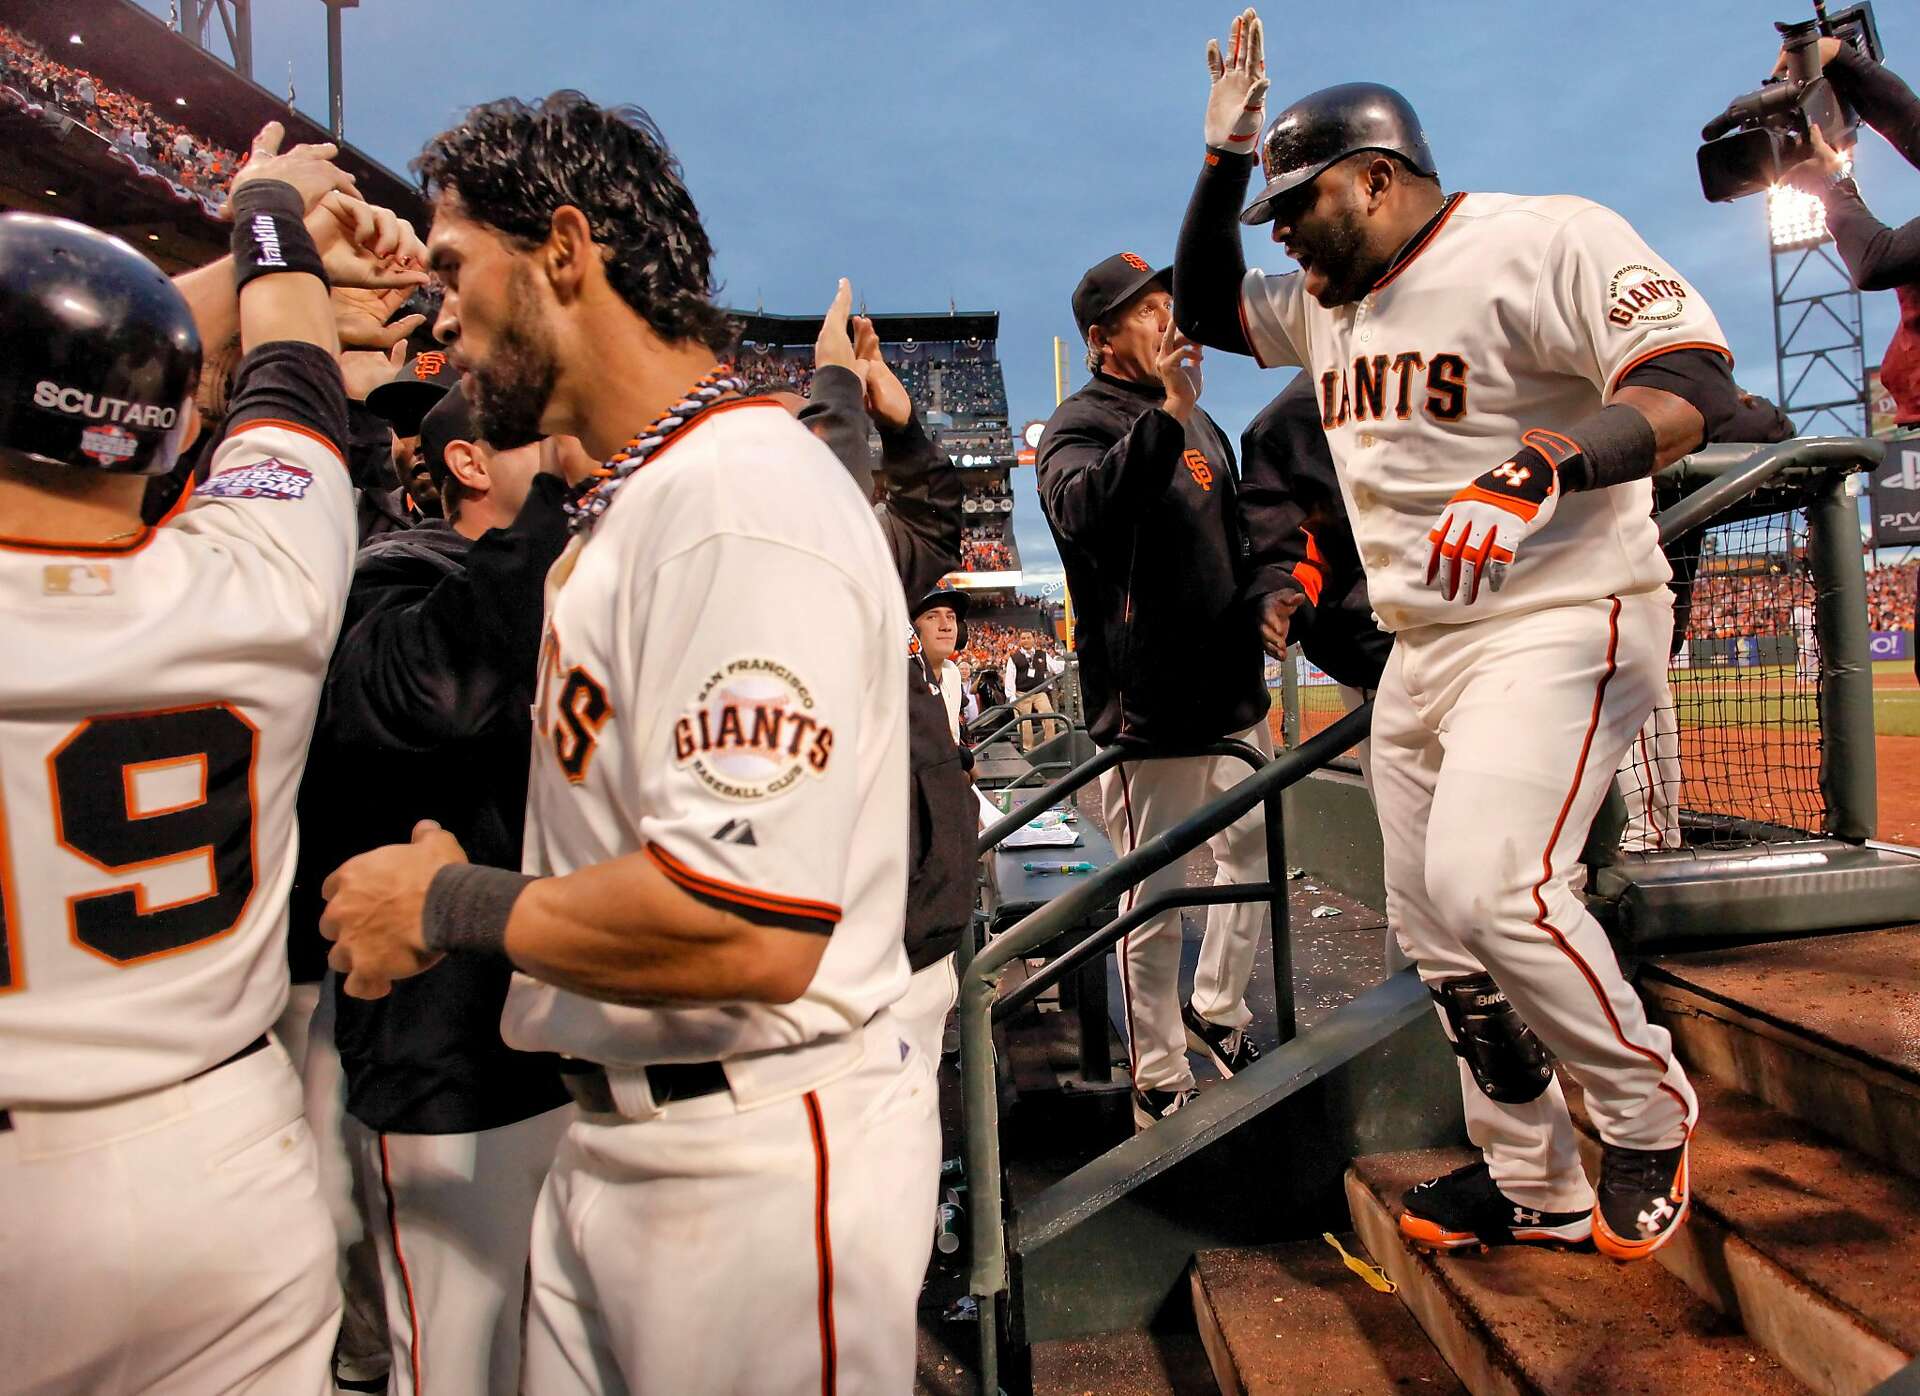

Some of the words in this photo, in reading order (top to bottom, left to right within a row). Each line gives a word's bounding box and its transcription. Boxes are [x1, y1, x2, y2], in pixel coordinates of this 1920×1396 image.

[1608, 279, 1687, 327] GIANTS
[33, 380, 178, 430] SCUTARO
[1870, 635, 1898, 655] O!
[698, 671, 724, 702] SAN
[726, 658, 815, 710] FRANCISCO
[674, 704, 835, 772] GIANTS
[693, 759, 764, 799] BASEBALL
[766, 765, 803, 793] CLUB
